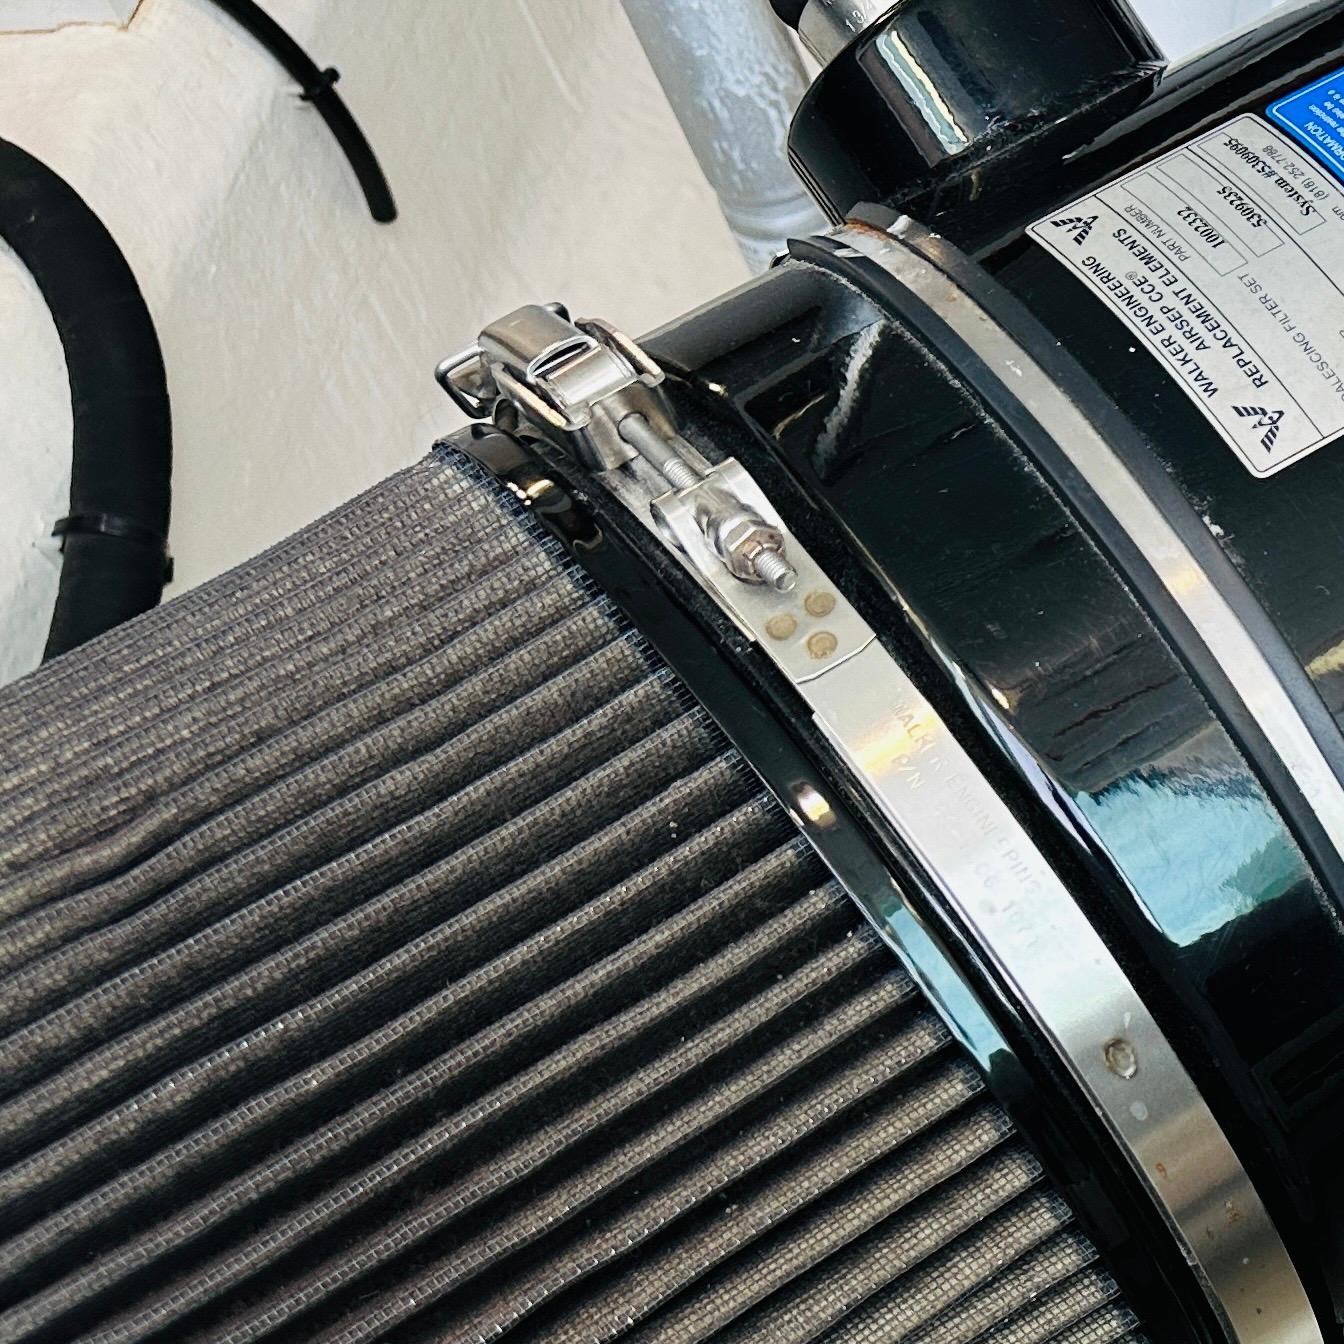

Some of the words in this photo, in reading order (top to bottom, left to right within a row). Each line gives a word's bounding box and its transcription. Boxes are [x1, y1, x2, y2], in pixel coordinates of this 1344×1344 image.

[1222, 135, 1277, 179] #5309095
[1215, 183, 1268, 229] 5309235
[1271, 176, 1318, 217] System
[1298, 175, 1330, 202] (818)
[1123, 202, 1167, 239] NUMBER
[1175, 205, 1225, 250] 1002332
[1112, 227, 1179, 287] ELEMENTS
[1159, 235, 1191, 262] PART
[1080, 254, 1166, 337] ENGINEERING
[1236, 271, 1263, 295] SET
[1158, 301, 1211, 352] AIRSEP
[1257, 292, 1297, 333] FILTER
[1172, 286, 1269, 389] REPLACEMENT
[1158, 332, 1218, 398] WALKER
